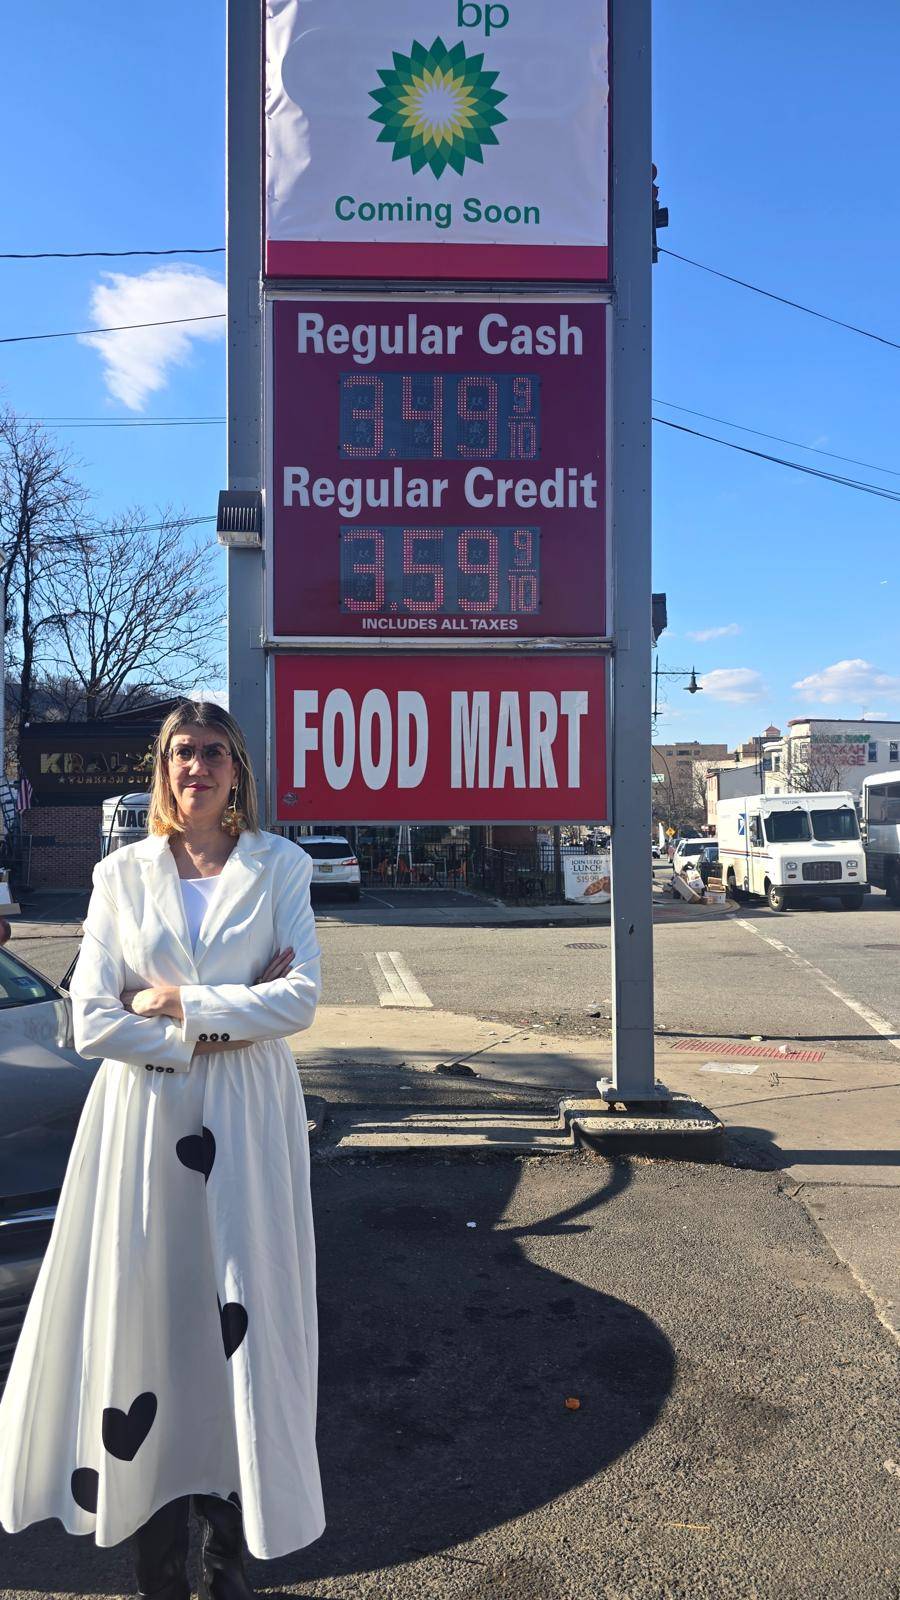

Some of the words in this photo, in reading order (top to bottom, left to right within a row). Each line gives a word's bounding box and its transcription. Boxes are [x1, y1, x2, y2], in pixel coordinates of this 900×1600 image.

[457, 0, 510, 37] bp
[334, 195, 452, 229] Coming
[462, 197, 541, 225] Soon
[297, 312, 463, 365] Regular
[478, 313, 583, 356] Cash
[343, 375, 498, 458] 3.49
[283, 465, 449, 519] Regular
[464, 466, 598, 509] Credit
[344, 529, 499, 612] 3.59
[361, 617, 437, 631] INCLUDES
[440, 617, 469, 631] ALL
[470, 618, 519, 631] TAXES
[293, 687, 429, 791] FOOD
[450, 690, 589, 789] MART
